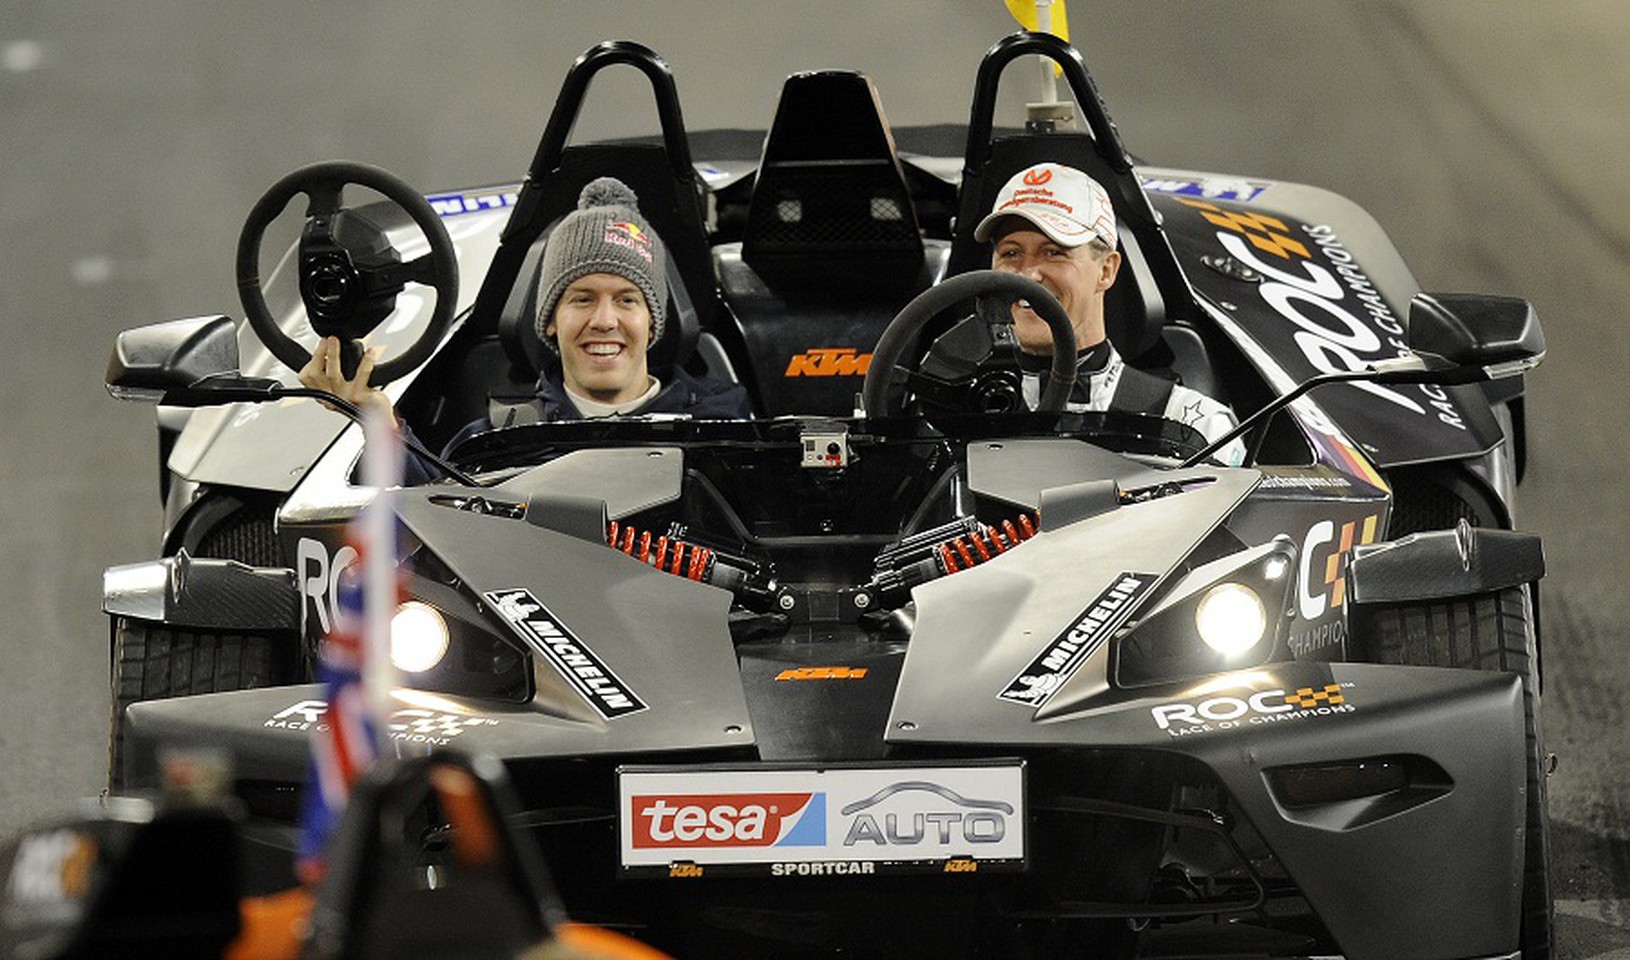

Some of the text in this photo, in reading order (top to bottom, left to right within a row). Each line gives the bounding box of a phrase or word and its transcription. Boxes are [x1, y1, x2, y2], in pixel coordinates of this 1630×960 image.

[1301, 224, 1404, 335] CHAMPIONS
[1216, 231, 1426, 415] ROC
[784, 347, 875, 377] KTM
[1418, 383, 1467, 430] RAC
[1041, 576, 1142, 671] MICHELIN
[526, 620, 634, 709] MICHELIN
[774, 666, 868, 681] KTM
[1151, 689, 1293, 729] ROC
[263, 719, 310, 731] RACE
[388, 732, 450, 745] PIONS
[843, 813, 1006, 846] AUTO
[771, 862, 875, 875] SPORTCAR
